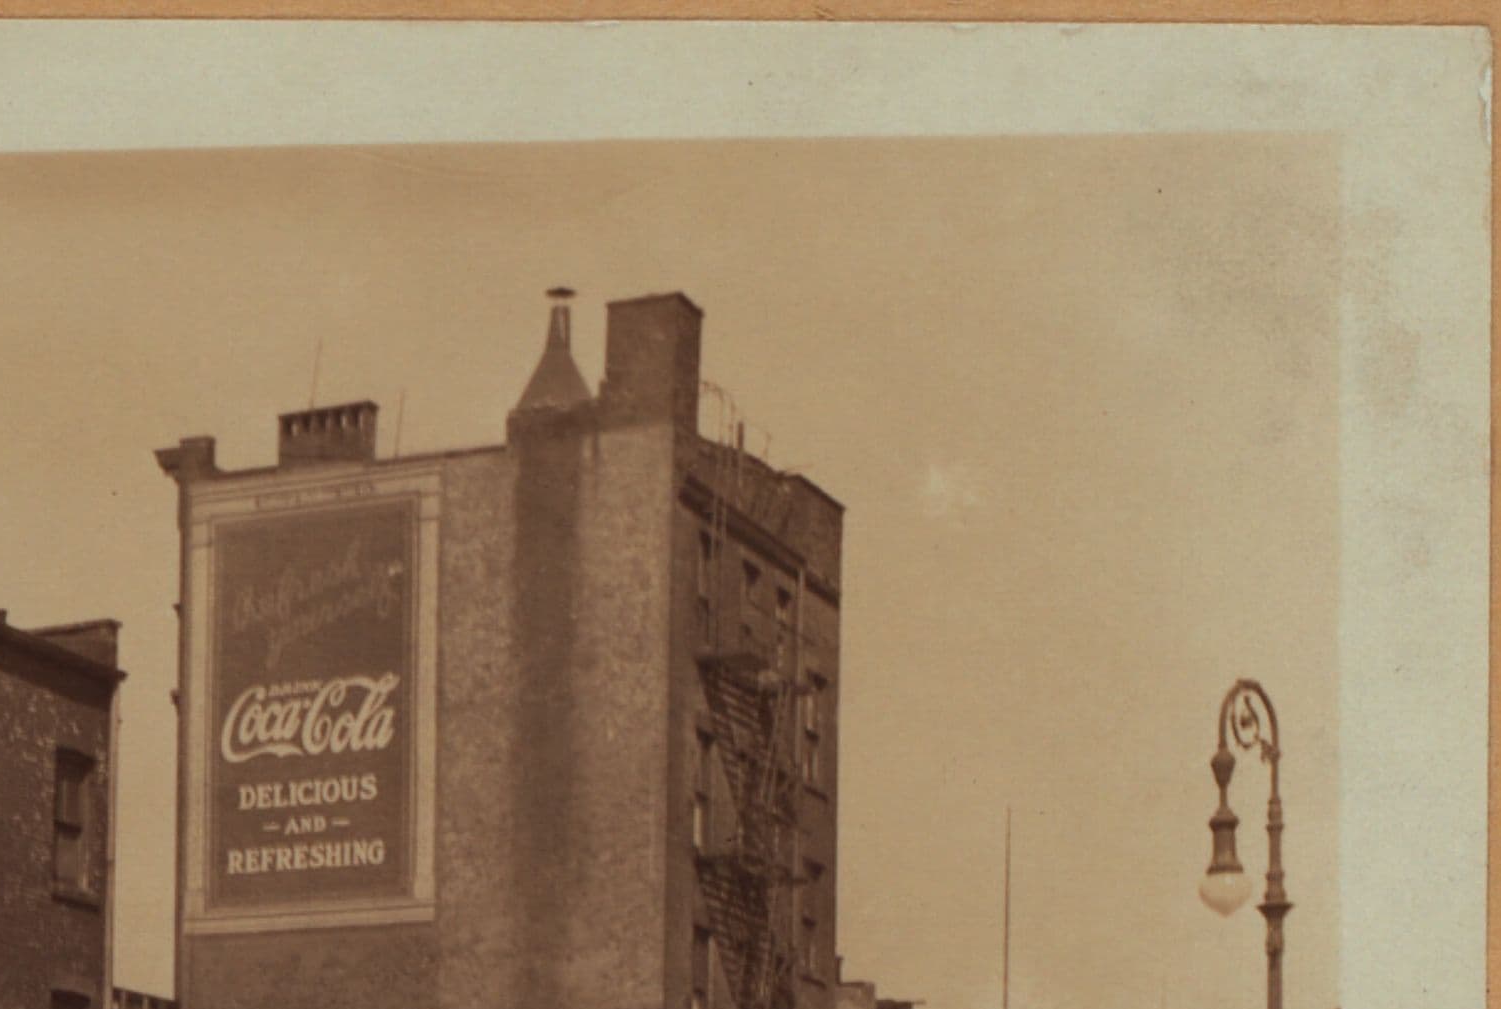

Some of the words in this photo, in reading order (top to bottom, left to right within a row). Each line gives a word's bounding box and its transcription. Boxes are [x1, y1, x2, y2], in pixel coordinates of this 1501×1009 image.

[239, 774, 377, 811] DELICIOUS
[284, 815, 327, 835] AND
[227, 839, 385, 875] REFRESHING
